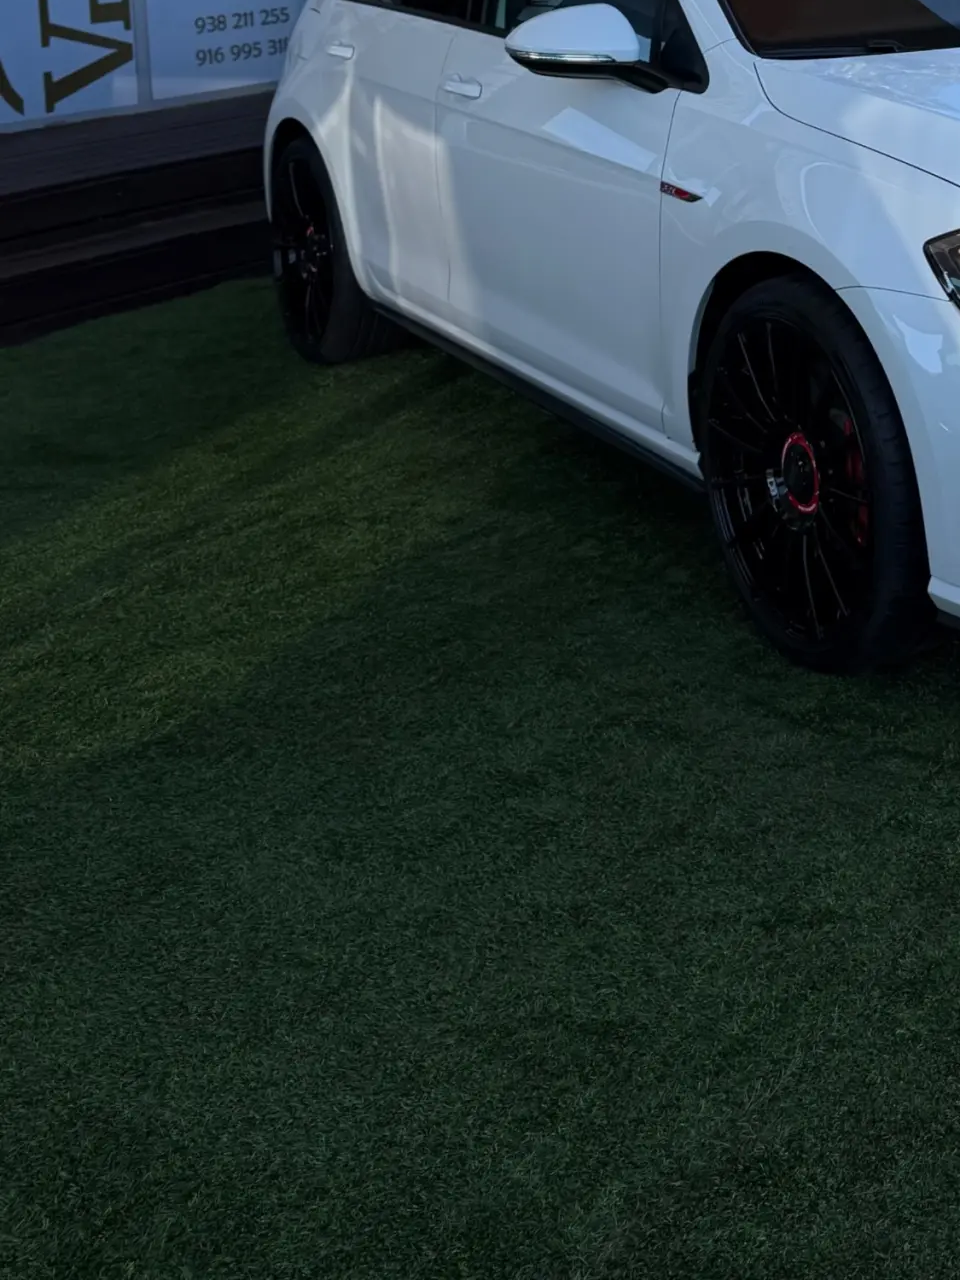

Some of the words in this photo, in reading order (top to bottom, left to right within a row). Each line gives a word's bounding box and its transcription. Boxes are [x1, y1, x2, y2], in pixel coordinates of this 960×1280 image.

[194, 14, 228, 35] 938
[232, 10, 254, 30] 211
[259, 6, 291, 26] 255
[196, 46, 225, 67] 916
[230, 41, 262, 62] 995
